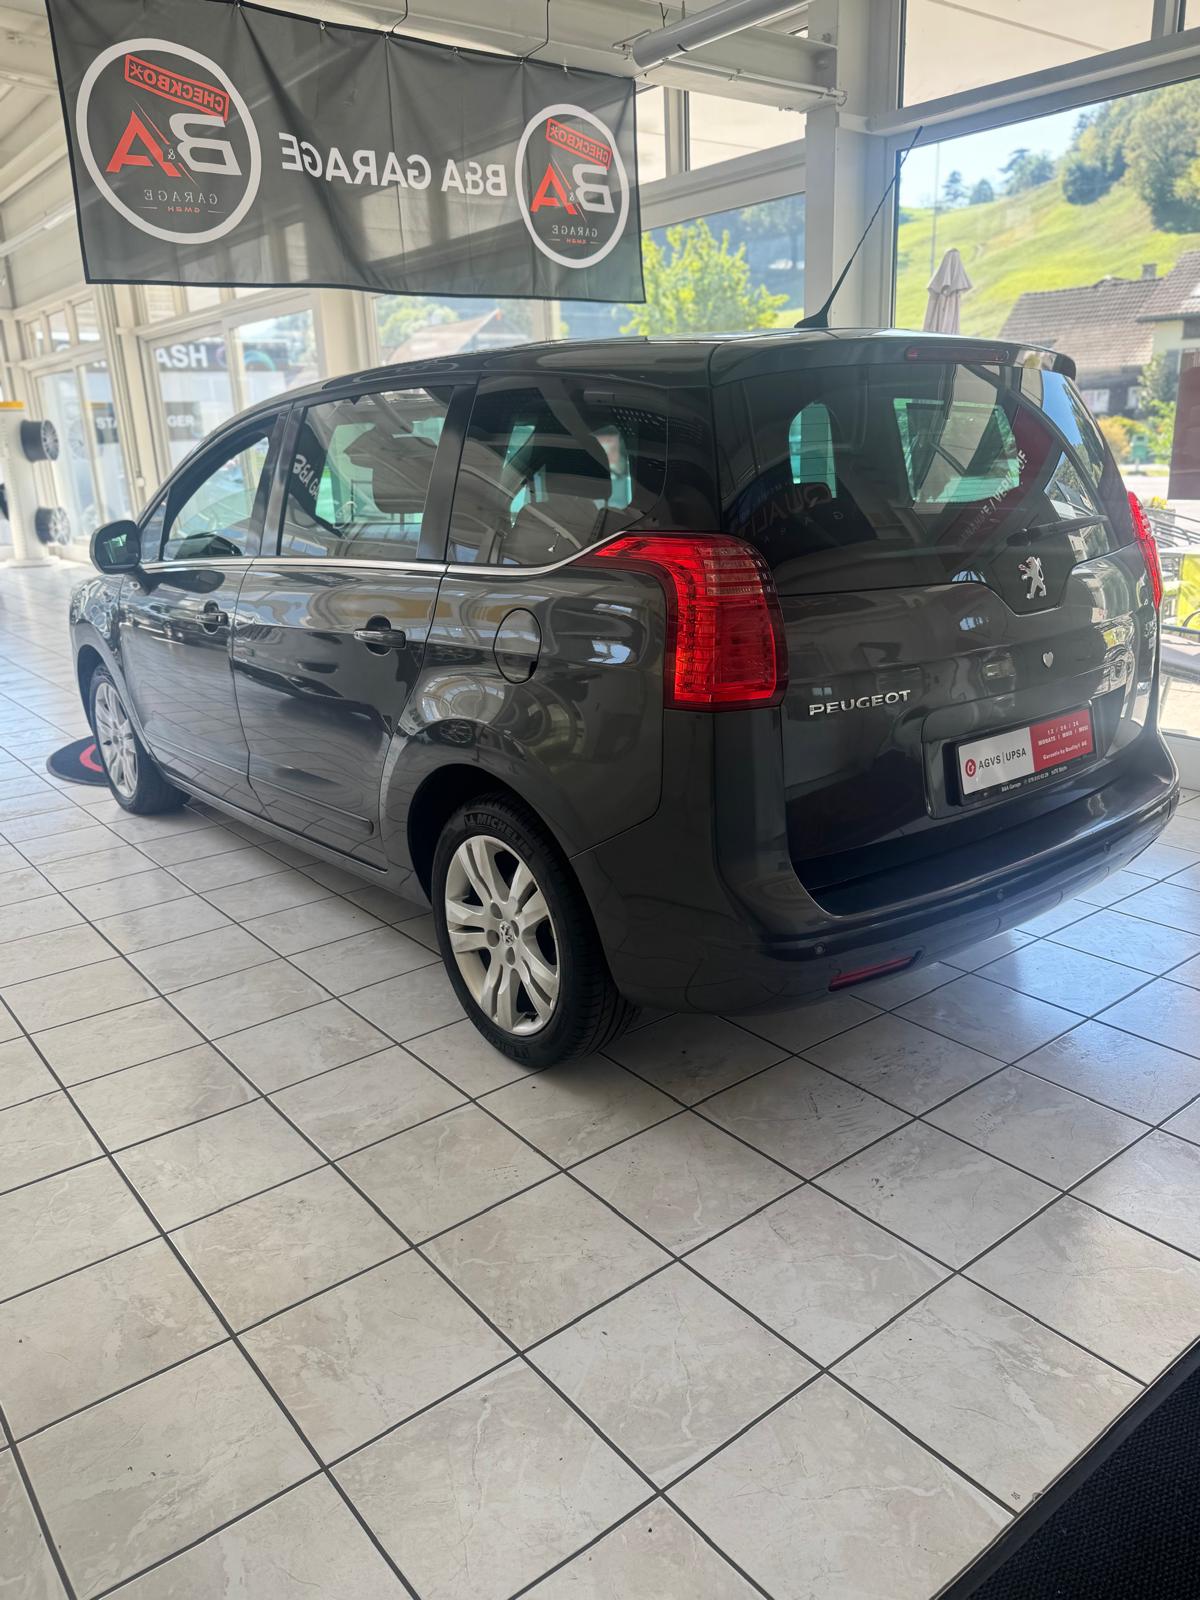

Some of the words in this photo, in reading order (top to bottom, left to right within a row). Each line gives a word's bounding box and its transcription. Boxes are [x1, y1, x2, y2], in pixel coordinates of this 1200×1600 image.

[156, 343, 208, 369] ASH
[808, 689, 911, 716] PEUGEOT
[978, 754, 1001, 770] AGVS
[1005, 747, 1027, 762] UPSA
